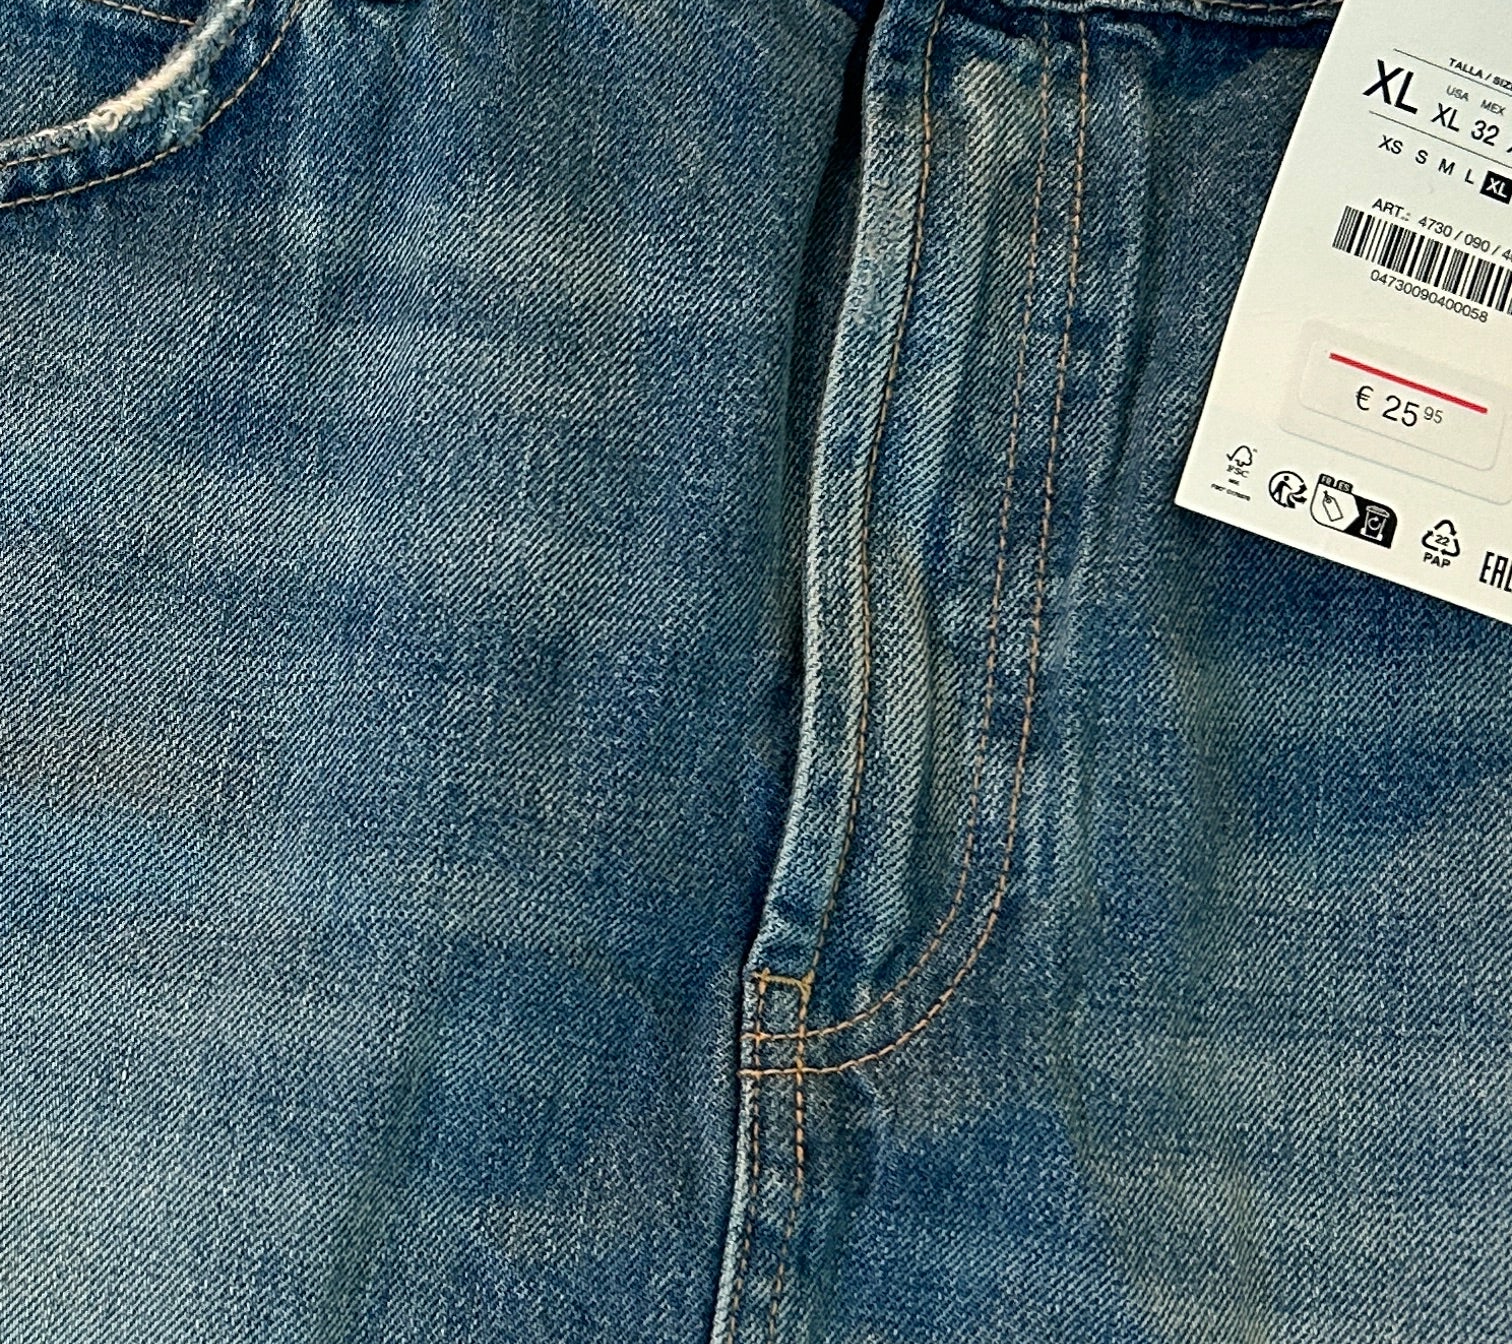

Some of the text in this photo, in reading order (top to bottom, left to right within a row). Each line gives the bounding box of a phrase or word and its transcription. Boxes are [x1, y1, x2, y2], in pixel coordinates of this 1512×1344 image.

[1449, 57, 1483, 79] TALLA
[1492, 76, 1512, 91] SIZ
[1362, 59, 1500, 147] XL XL 32
[1446, 85, 1506, 117] USA MEX
[1378, 134, 1508, 198] XS S M L XL
[1418, 216, 1453, 238] 4730
[1464, 233, 1491, 253] 090
[1501, 249, 1512, 262] 4
[1370, 269, 1489, 323] 04730090400058
[1355, 385, 1374, 411] €
[1226, 464, 1250, 478] FSC
[1434, 534, 1450, 547] 22
[1423, 551, 1451, 568] PAP
